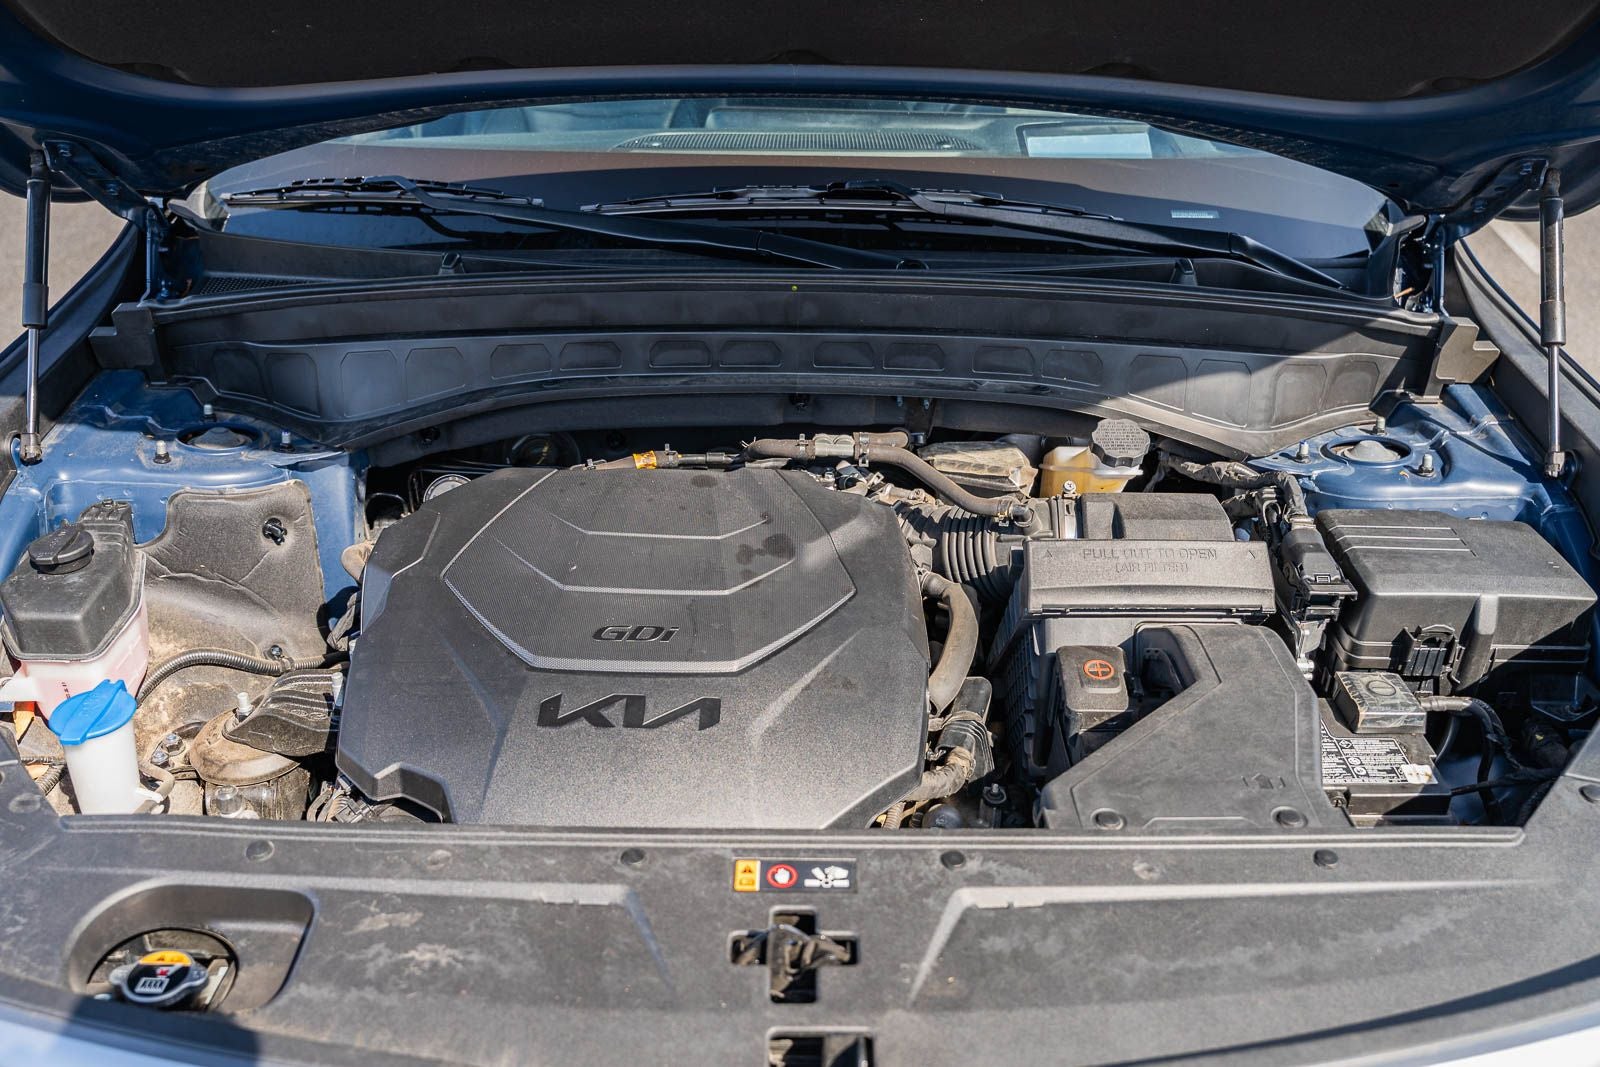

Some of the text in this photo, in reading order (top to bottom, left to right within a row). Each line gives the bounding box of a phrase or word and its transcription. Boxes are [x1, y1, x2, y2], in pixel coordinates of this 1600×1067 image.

[1082, 548, 1217, 560] PULL OUT TO OPEN
[592, 625, 680, 642] GDi
[537, 692, 722, 731] KIA
